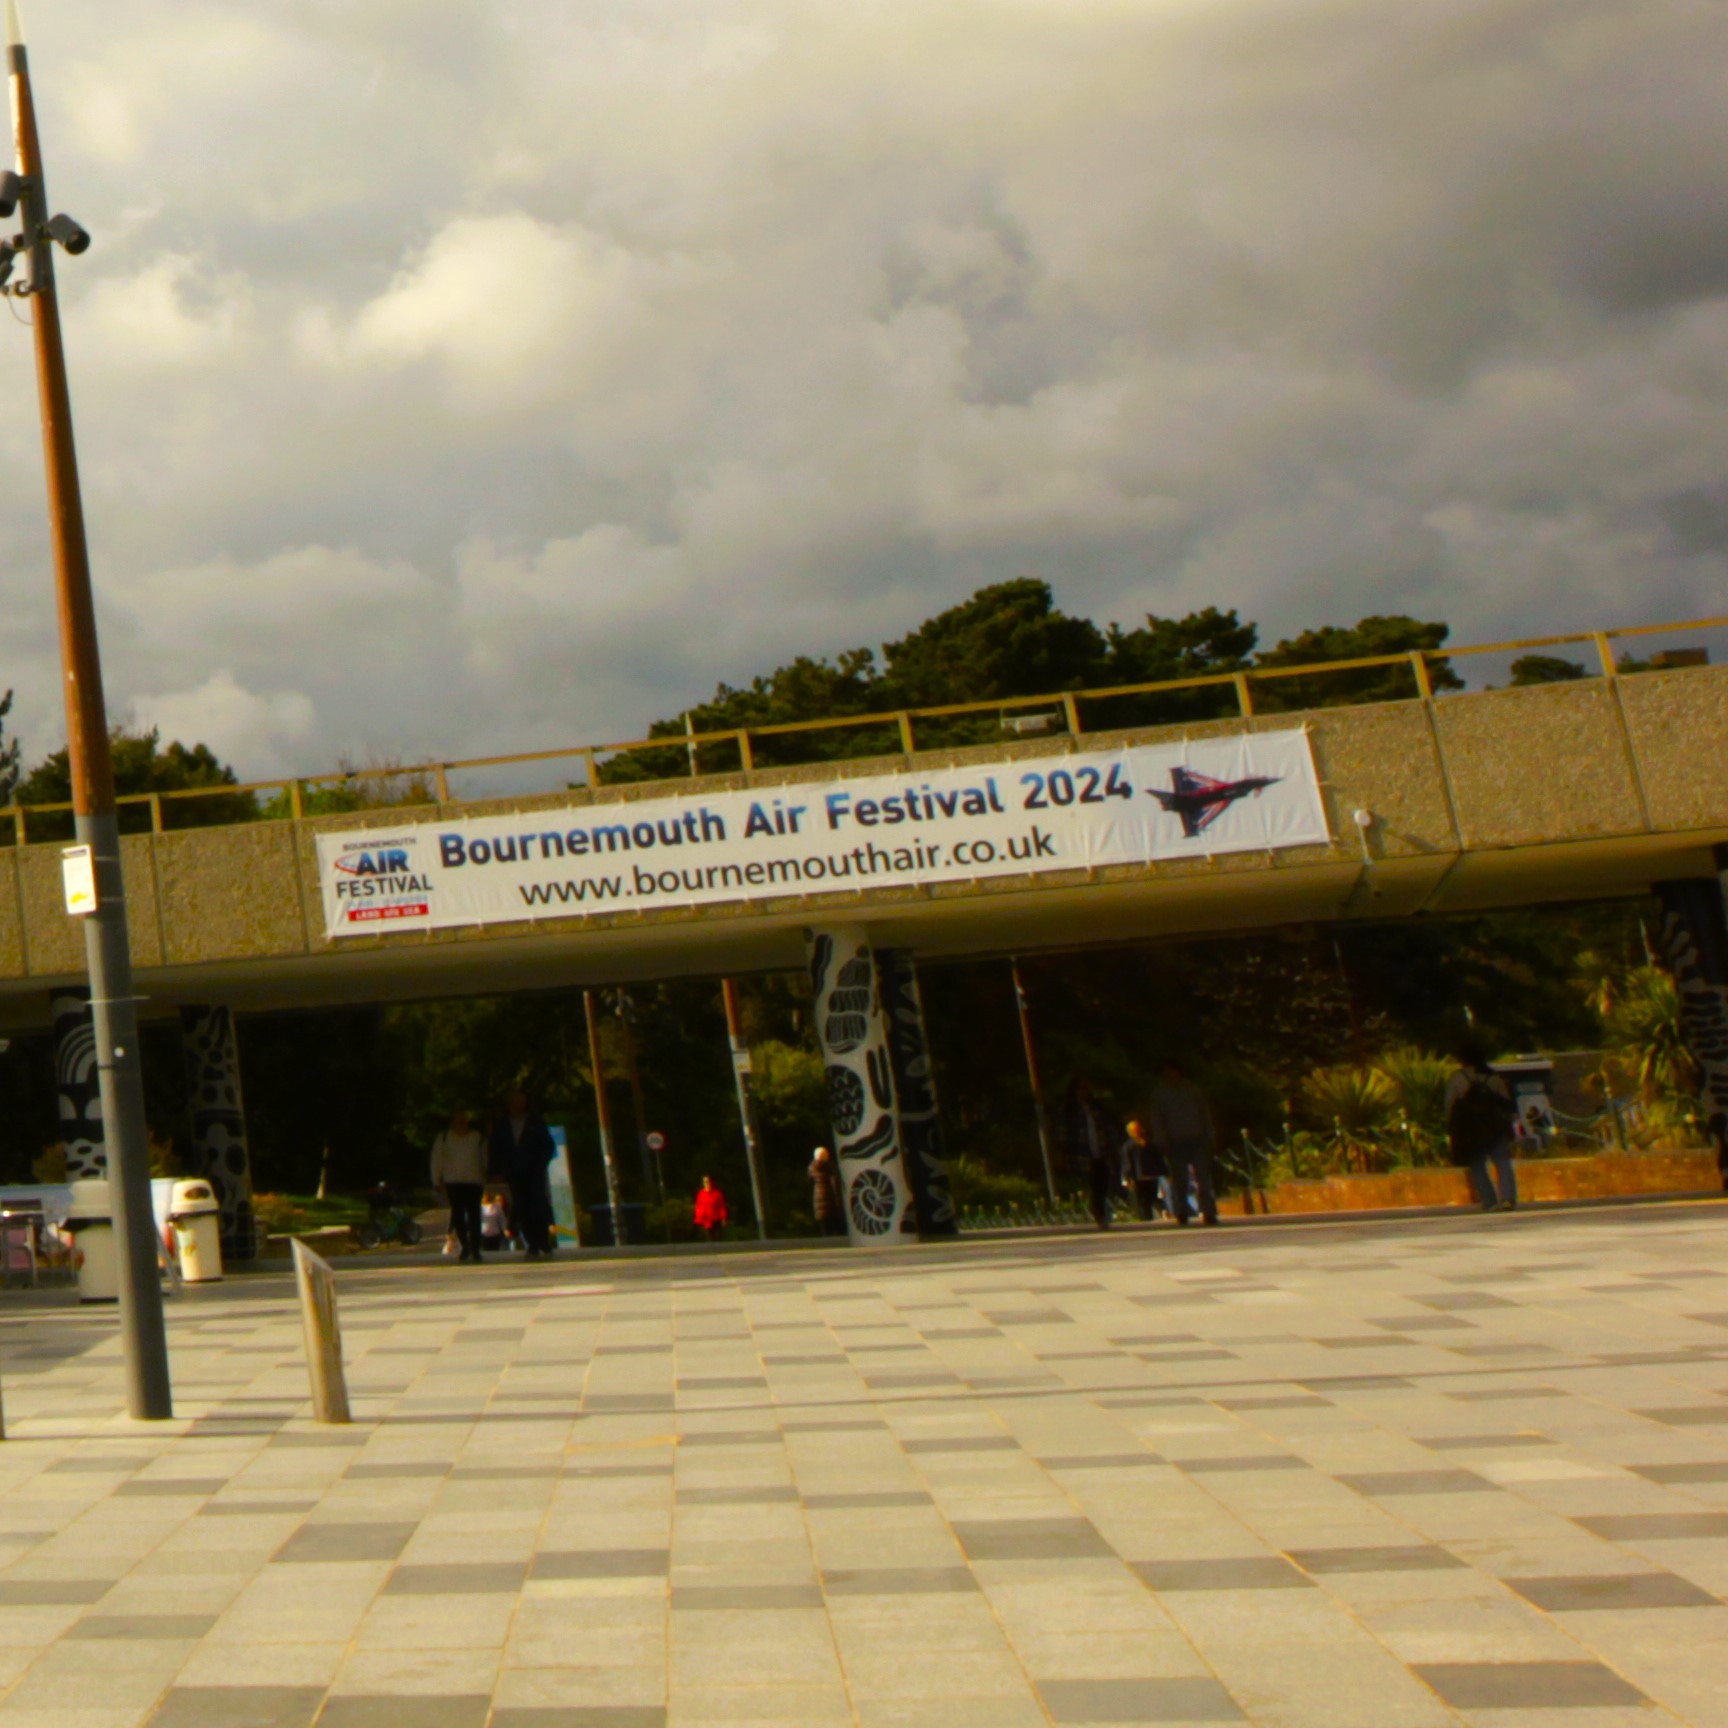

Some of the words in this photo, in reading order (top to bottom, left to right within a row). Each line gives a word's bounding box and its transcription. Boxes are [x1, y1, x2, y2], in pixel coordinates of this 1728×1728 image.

[438, 807, 726, 868] Bournemouth
[744, 800, 807, 839] Air
[825, 777, 1005, 830] Festival
[1020, 762, 1133, 811] 2024
[342, 837, 417, 851] BOURNEMOUTH
[355, 849, 410, 876] AIR
[518, 824, 1057, 906] www.bournemouthair.co.uk
[336, 873, 433, 899] FESTIVAL
